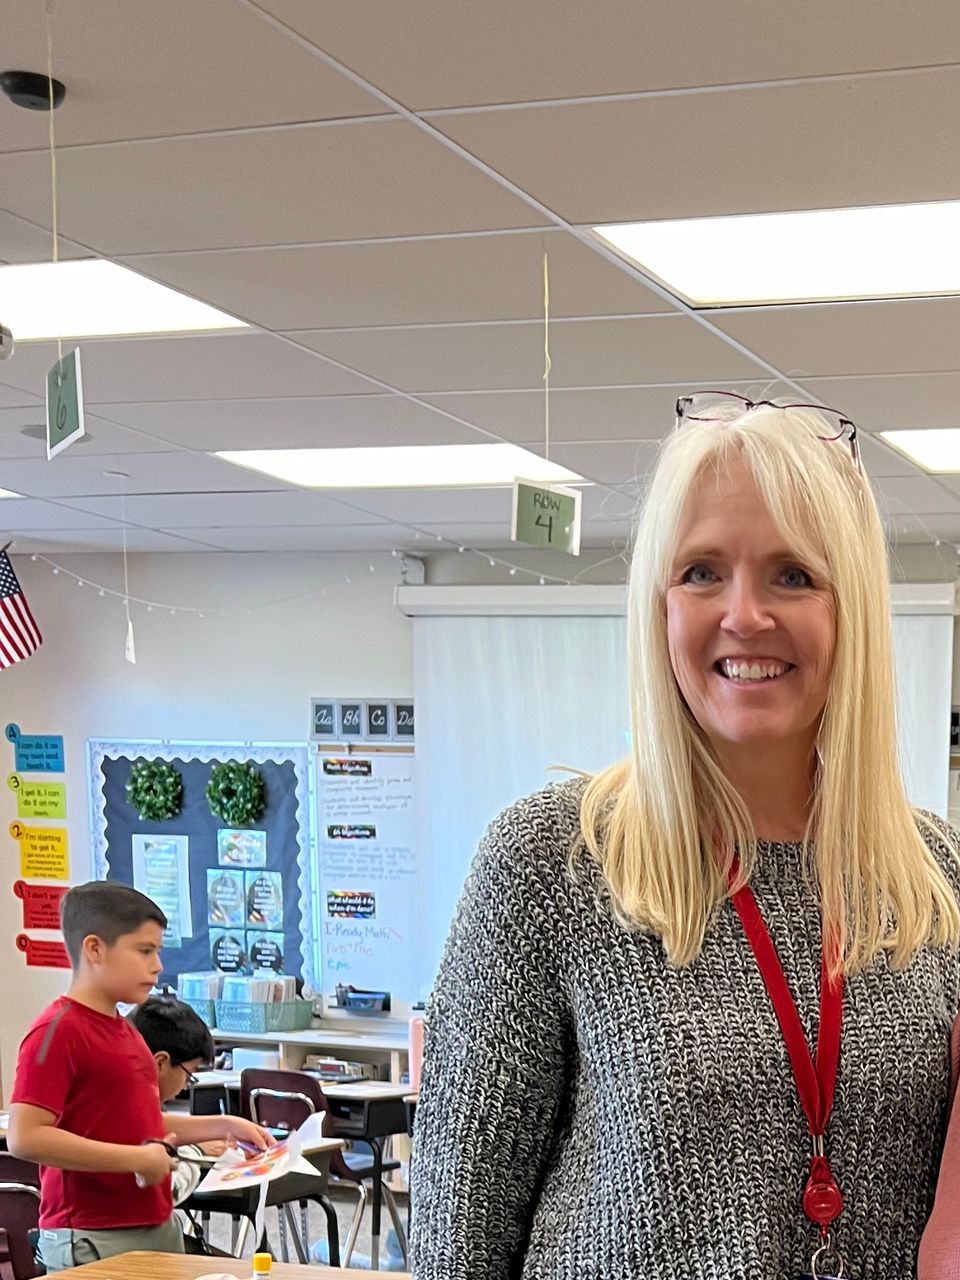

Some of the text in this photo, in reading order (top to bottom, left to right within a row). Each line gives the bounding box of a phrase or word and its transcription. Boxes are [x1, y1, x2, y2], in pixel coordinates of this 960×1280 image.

[533, 492, 561, 512] ROW
[534, 514, 552, 543] 4
[343, 709, 359, 725] Bb
[371, 709, 385, 725] Cc
[10, 776, 19, 788] 3
[12, 825, 22, 837] 2
[18, 884, 24, 896] 1
